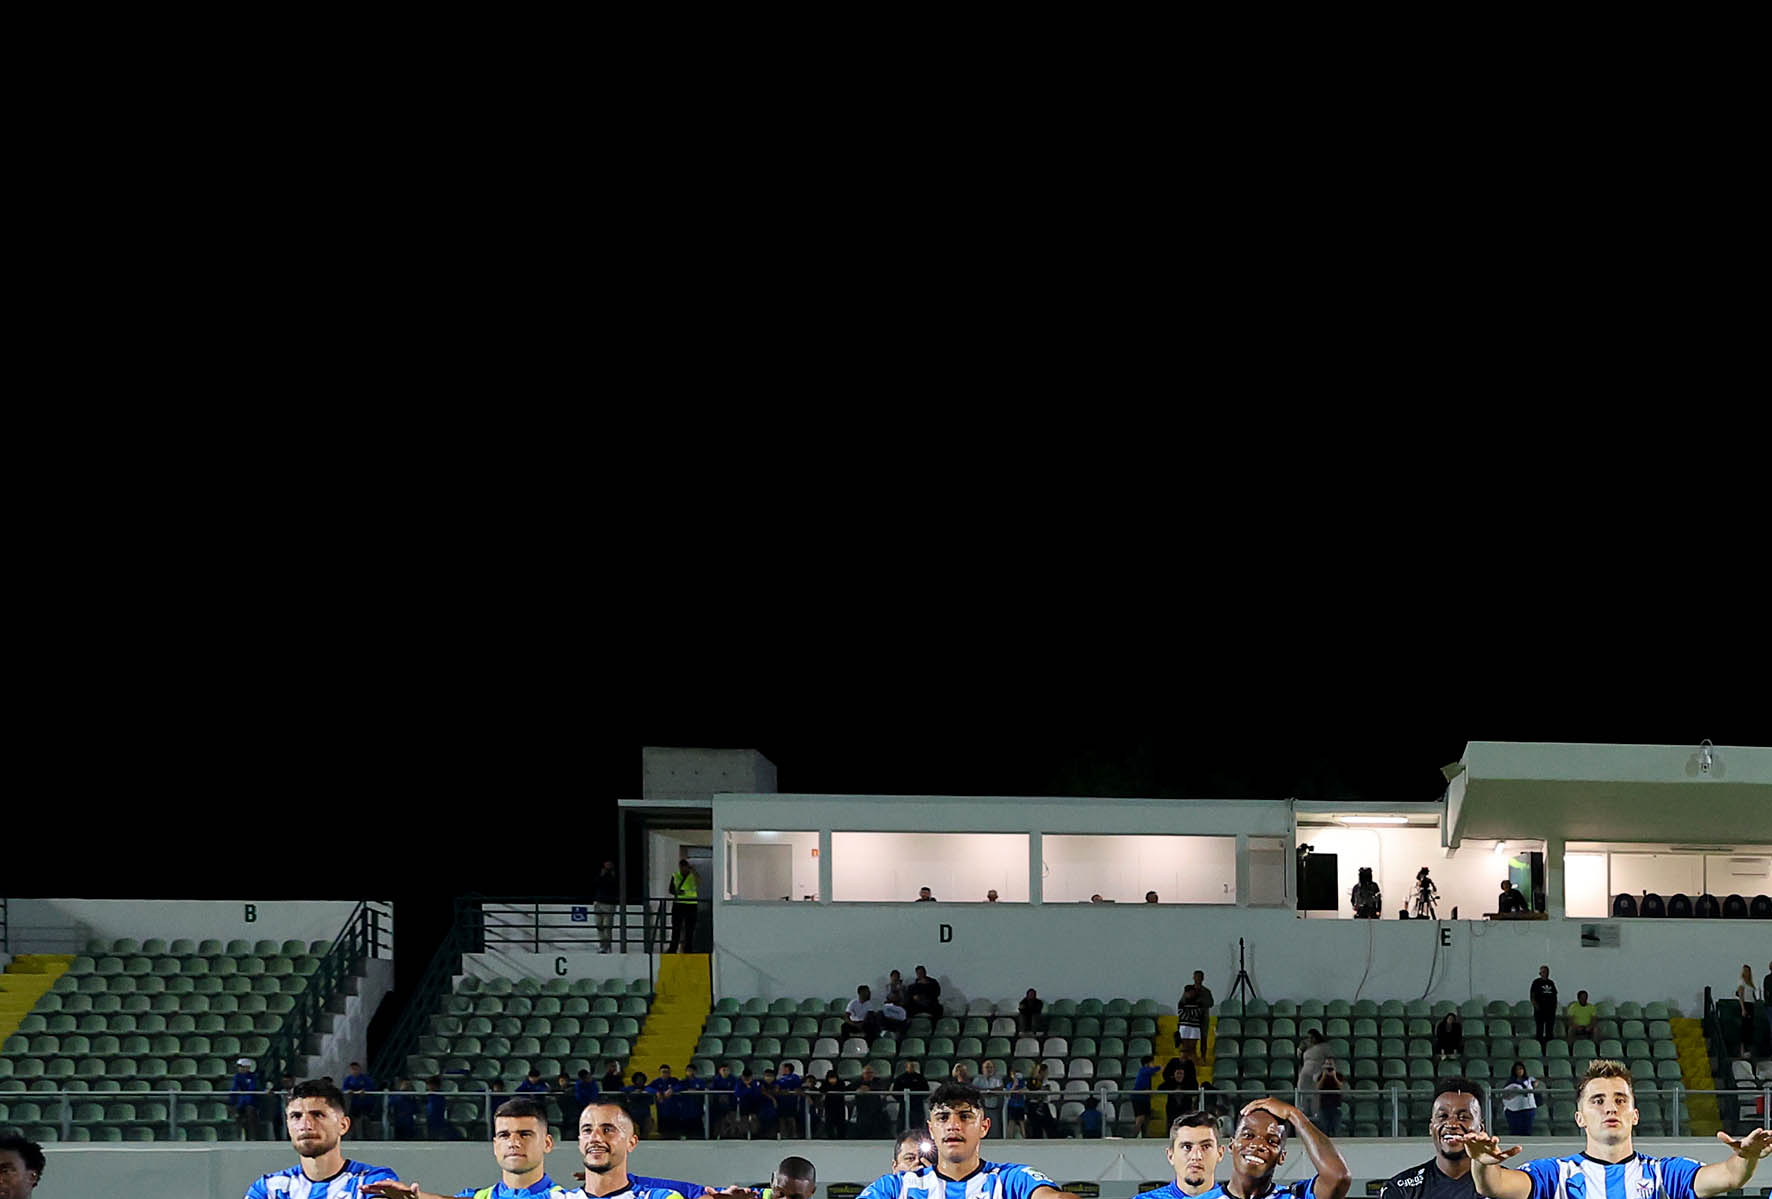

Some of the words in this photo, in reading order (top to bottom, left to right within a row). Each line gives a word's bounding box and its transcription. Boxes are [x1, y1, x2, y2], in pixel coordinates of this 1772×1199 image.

[245, 904, 257, 923] B
[939, 924, 953, 943] D
[1441, 928, 1451, 947] E
[555, 956, 568, 976] C
